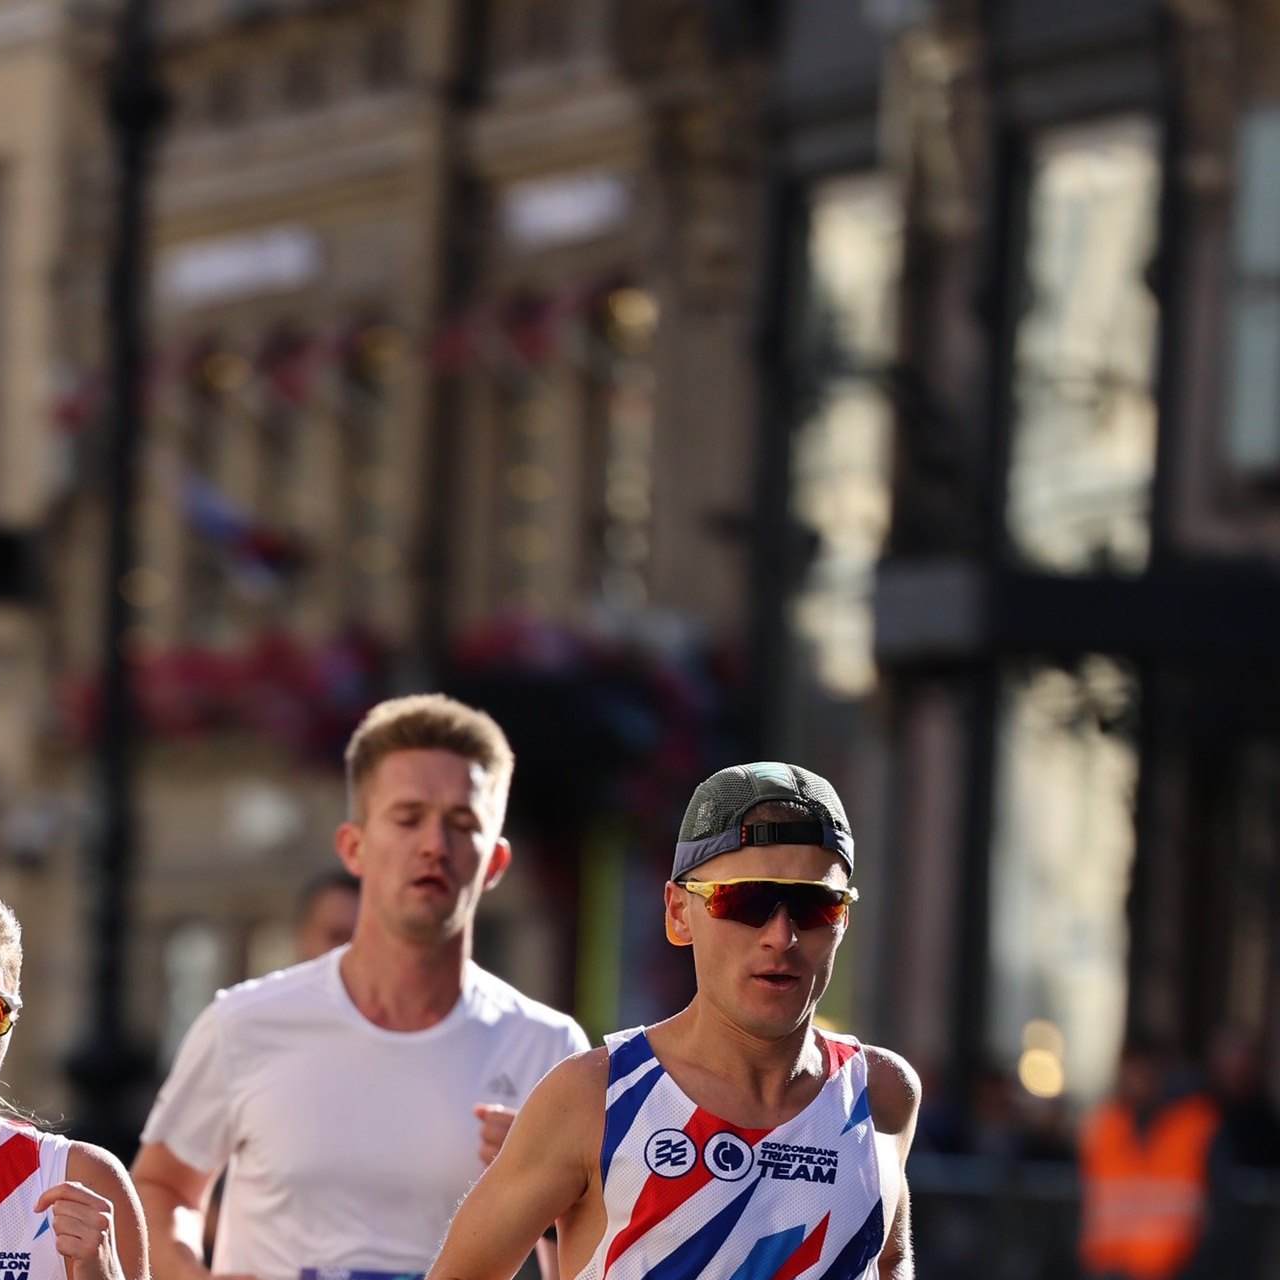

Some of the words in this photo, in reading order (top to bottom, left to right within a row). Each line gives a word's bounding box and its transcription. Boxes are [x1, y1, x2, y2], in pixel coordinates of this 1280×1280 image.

[760, 1149, 839, 1167] TRIATHLON
[762, 1141, 839, 1159] SOVCOMBANK
[757, 1160, 837, 1185] TEAM
